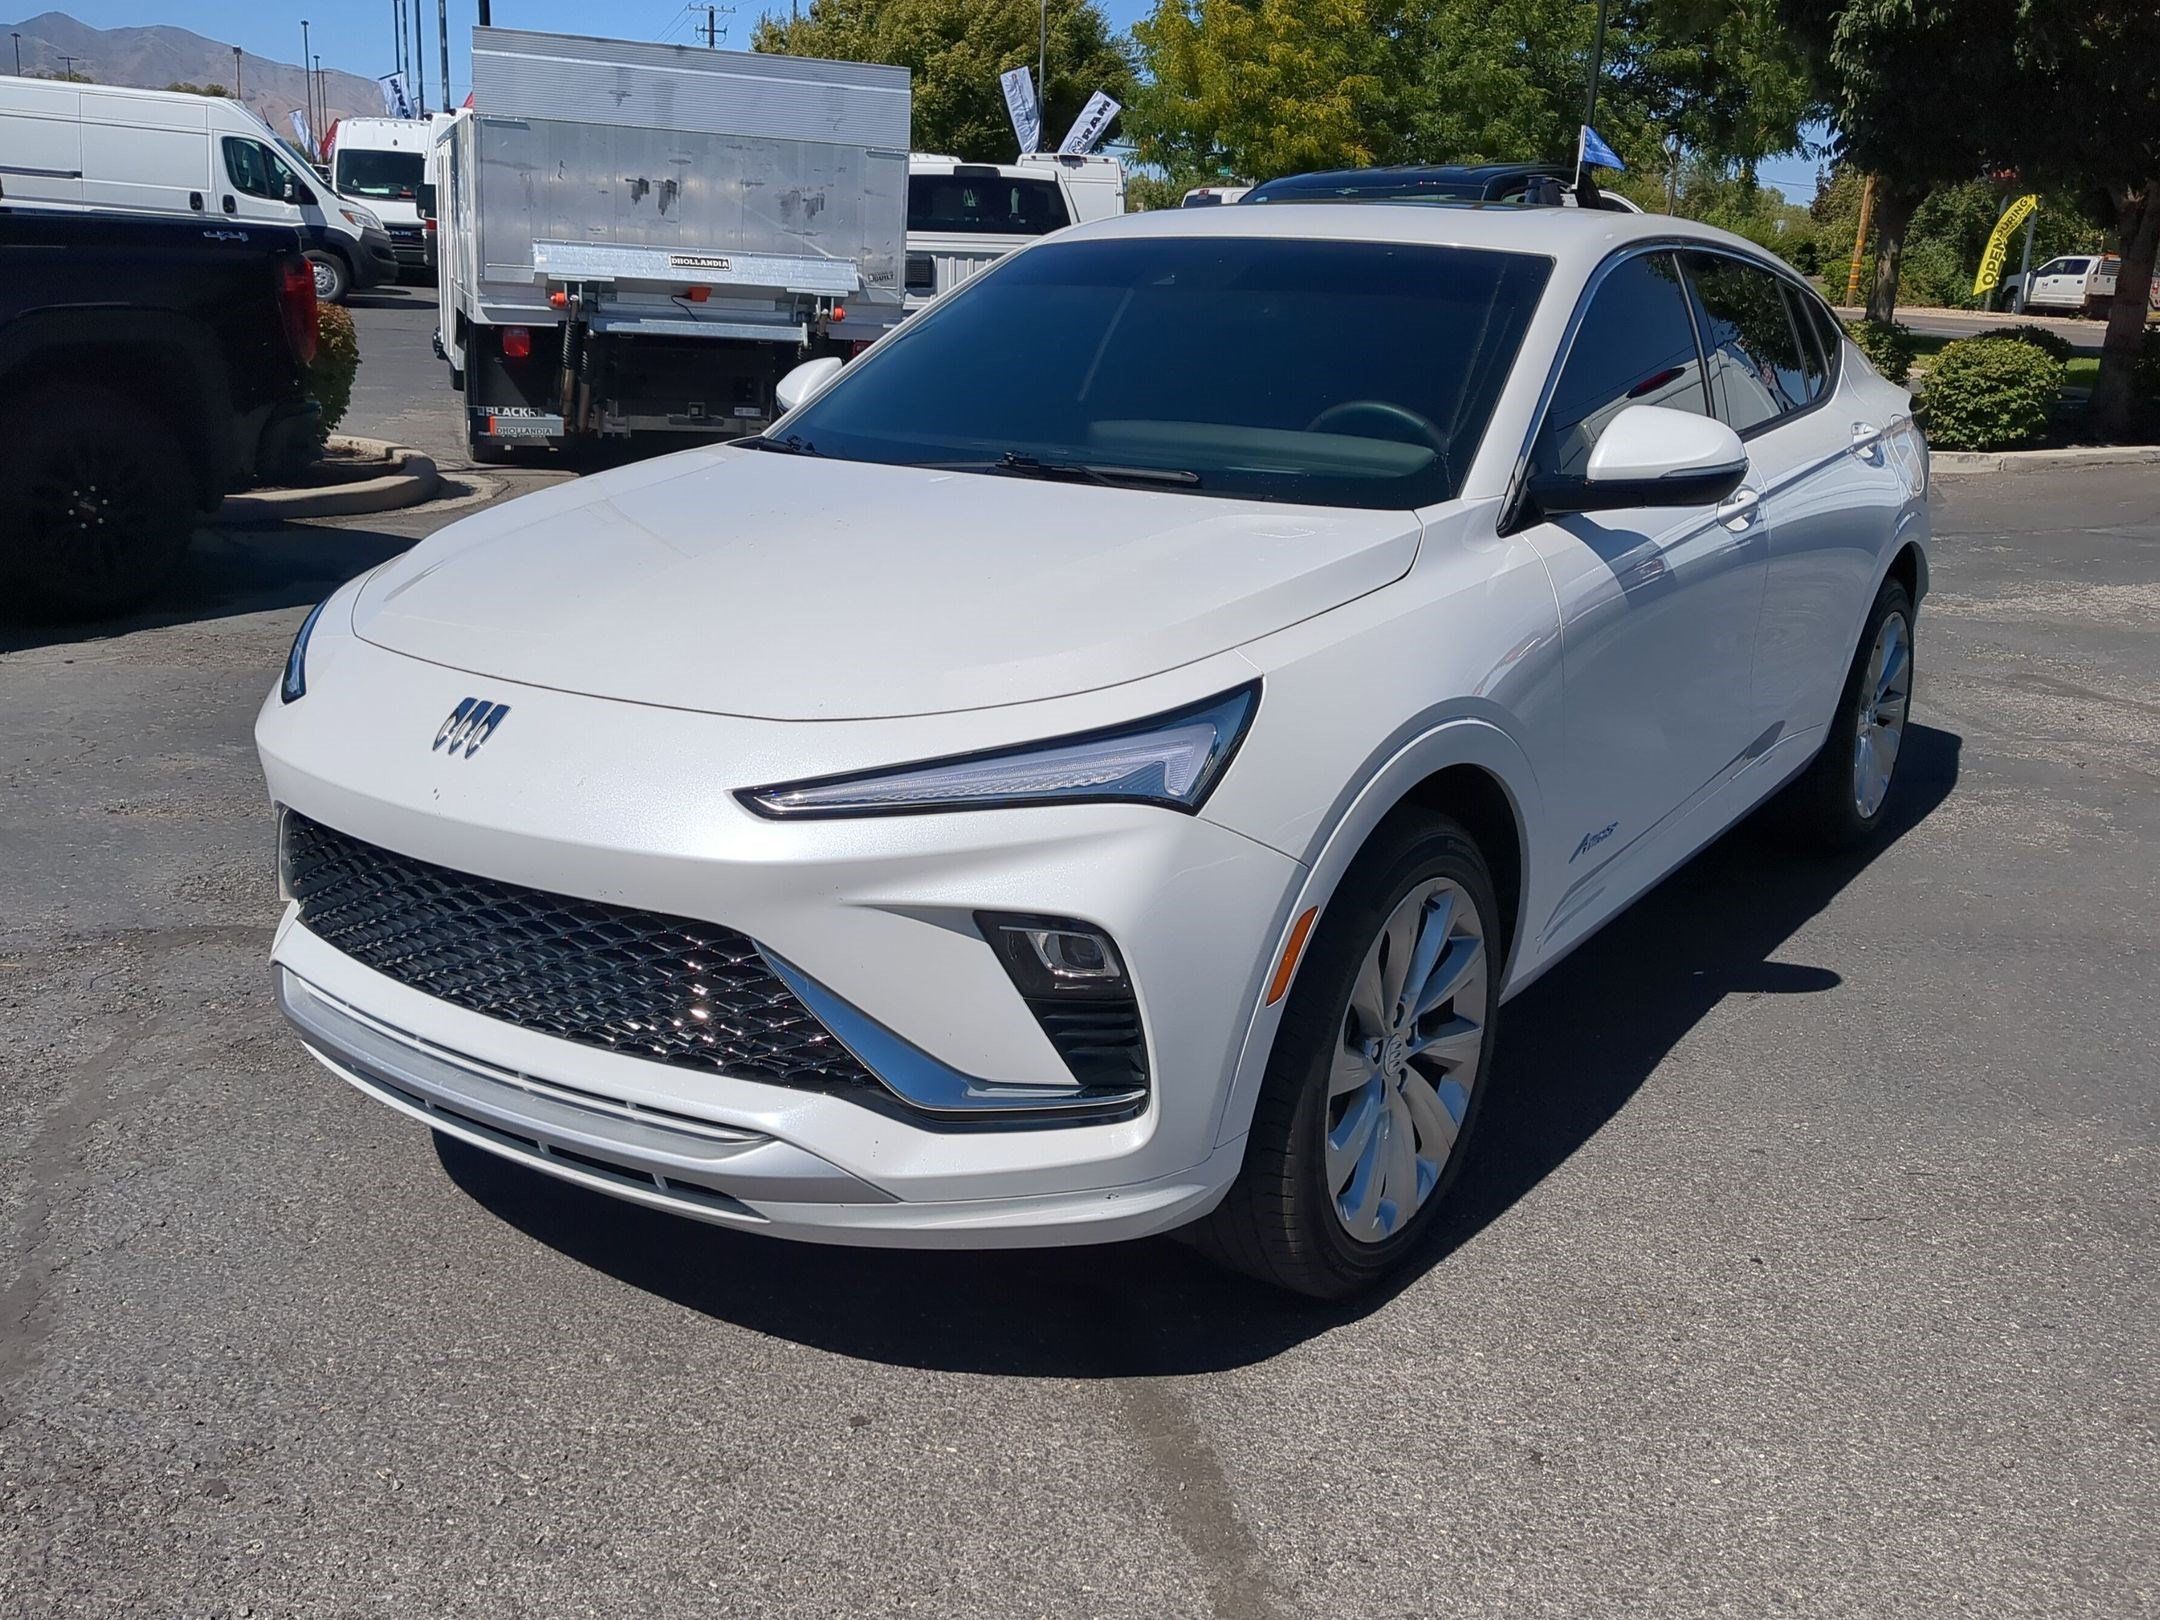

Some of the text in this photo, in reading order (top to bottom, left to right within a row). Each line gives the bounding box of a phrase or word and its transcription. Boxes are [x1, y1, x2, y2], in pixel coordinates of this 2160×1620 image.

[1081, 100, 1111, 140] RAM
[671, 258, 729, 267] DHOLLANDIA
[1981, 236, 2005, 286] OPEN
[496, 427, 552, 435] DHOLLANDIA
